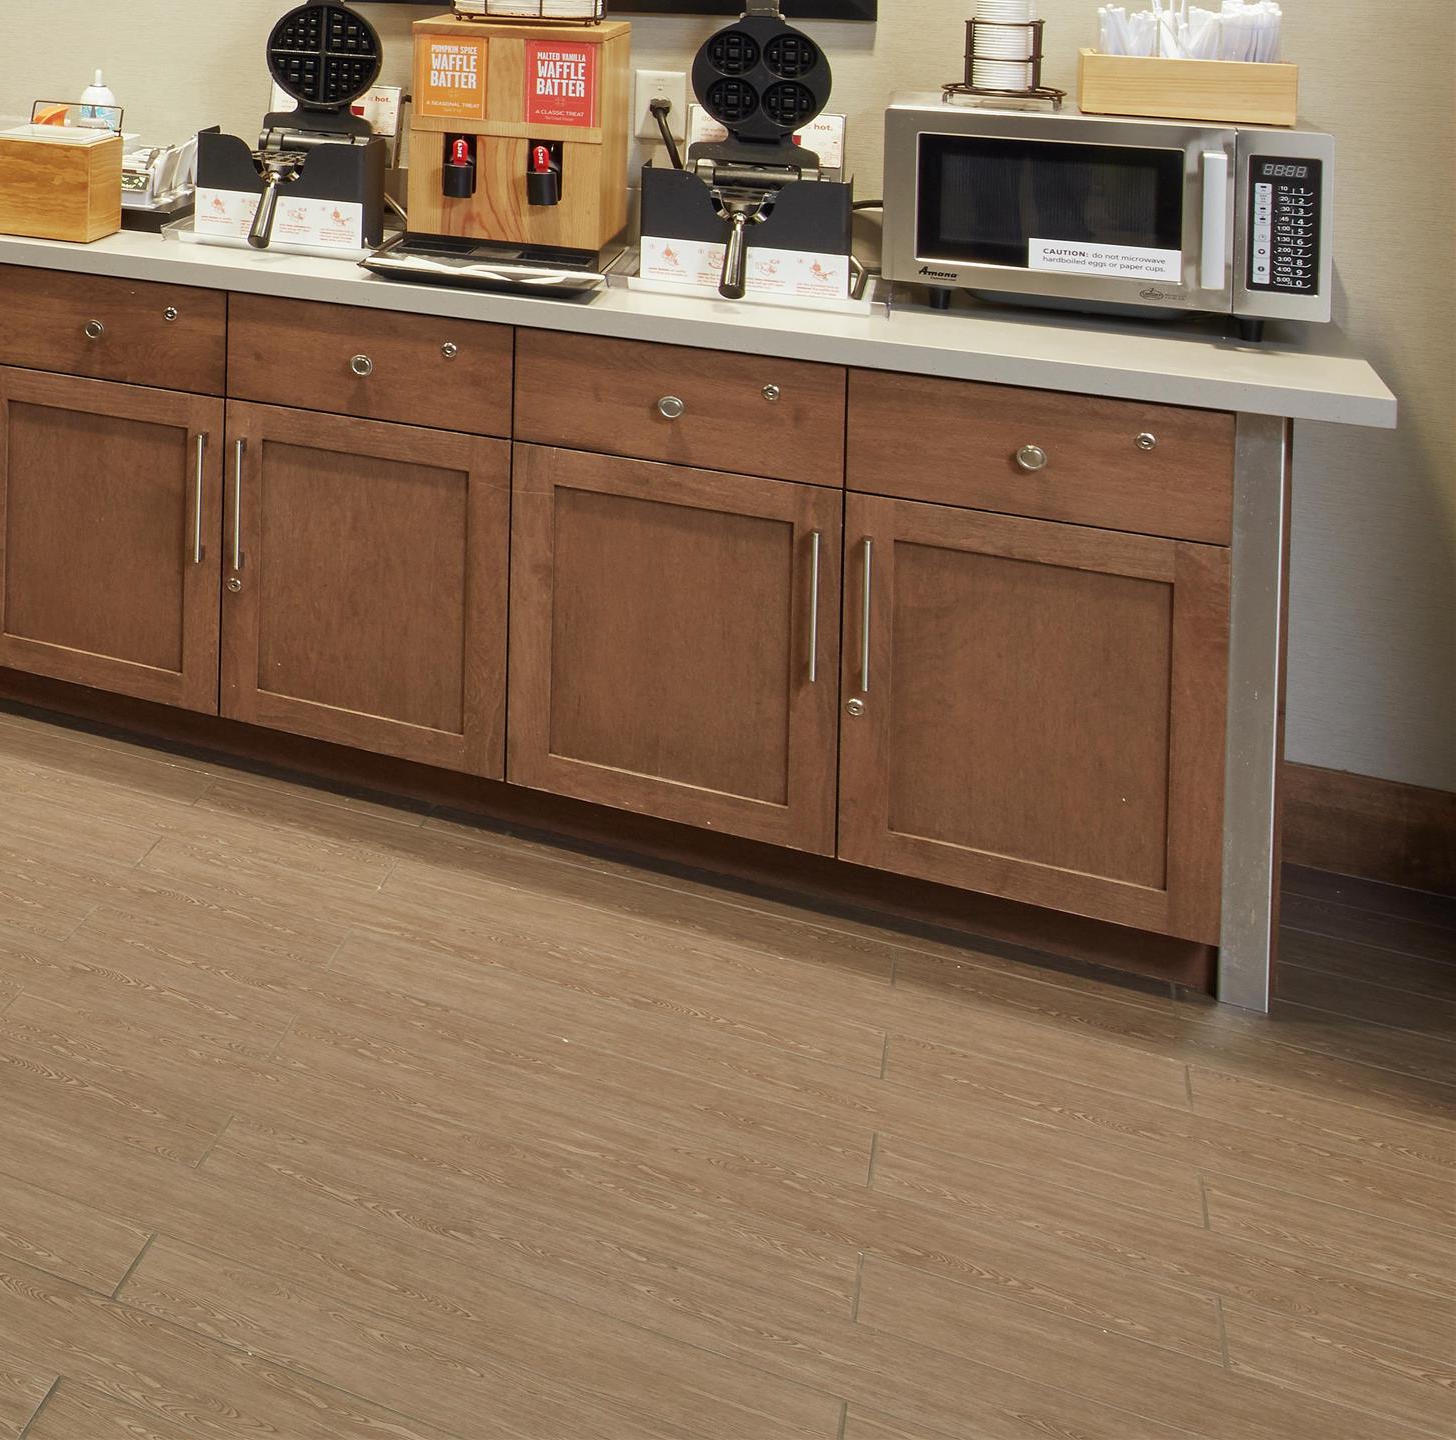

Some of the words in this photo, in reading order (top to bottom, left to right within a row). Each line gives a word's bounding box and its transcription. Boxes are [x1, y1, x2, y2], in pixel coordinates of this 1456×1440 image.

[431, 44, 459, 54] PUMPKIN
[460, 46, 478, 55] SPICE
[537, 52, 561, 61] MALTED
[561, 52, 586, 62] VANILLA
[431, 53, 478, 72] WAFFLE
[537, 60, 586, 80] WAFFLE
[430, 71, 477, 89] BATTER
[536, 78, 585, 98] BATTER
[813, 123, 833, 131] hot.
[1042, 256, 1086, 266] hardboiled
[1088, 260, 1107, 268] eggs
[1119, 263, 1143, 271] paper
[1145, 265, 1166, 273] cups.
[1043, 247, 1089, 257] CAUTION:
[1105, 253, 1119, 261] not
[1121, 255, 1166, 265] microwave
[919, 266, 958, 278] Amana
